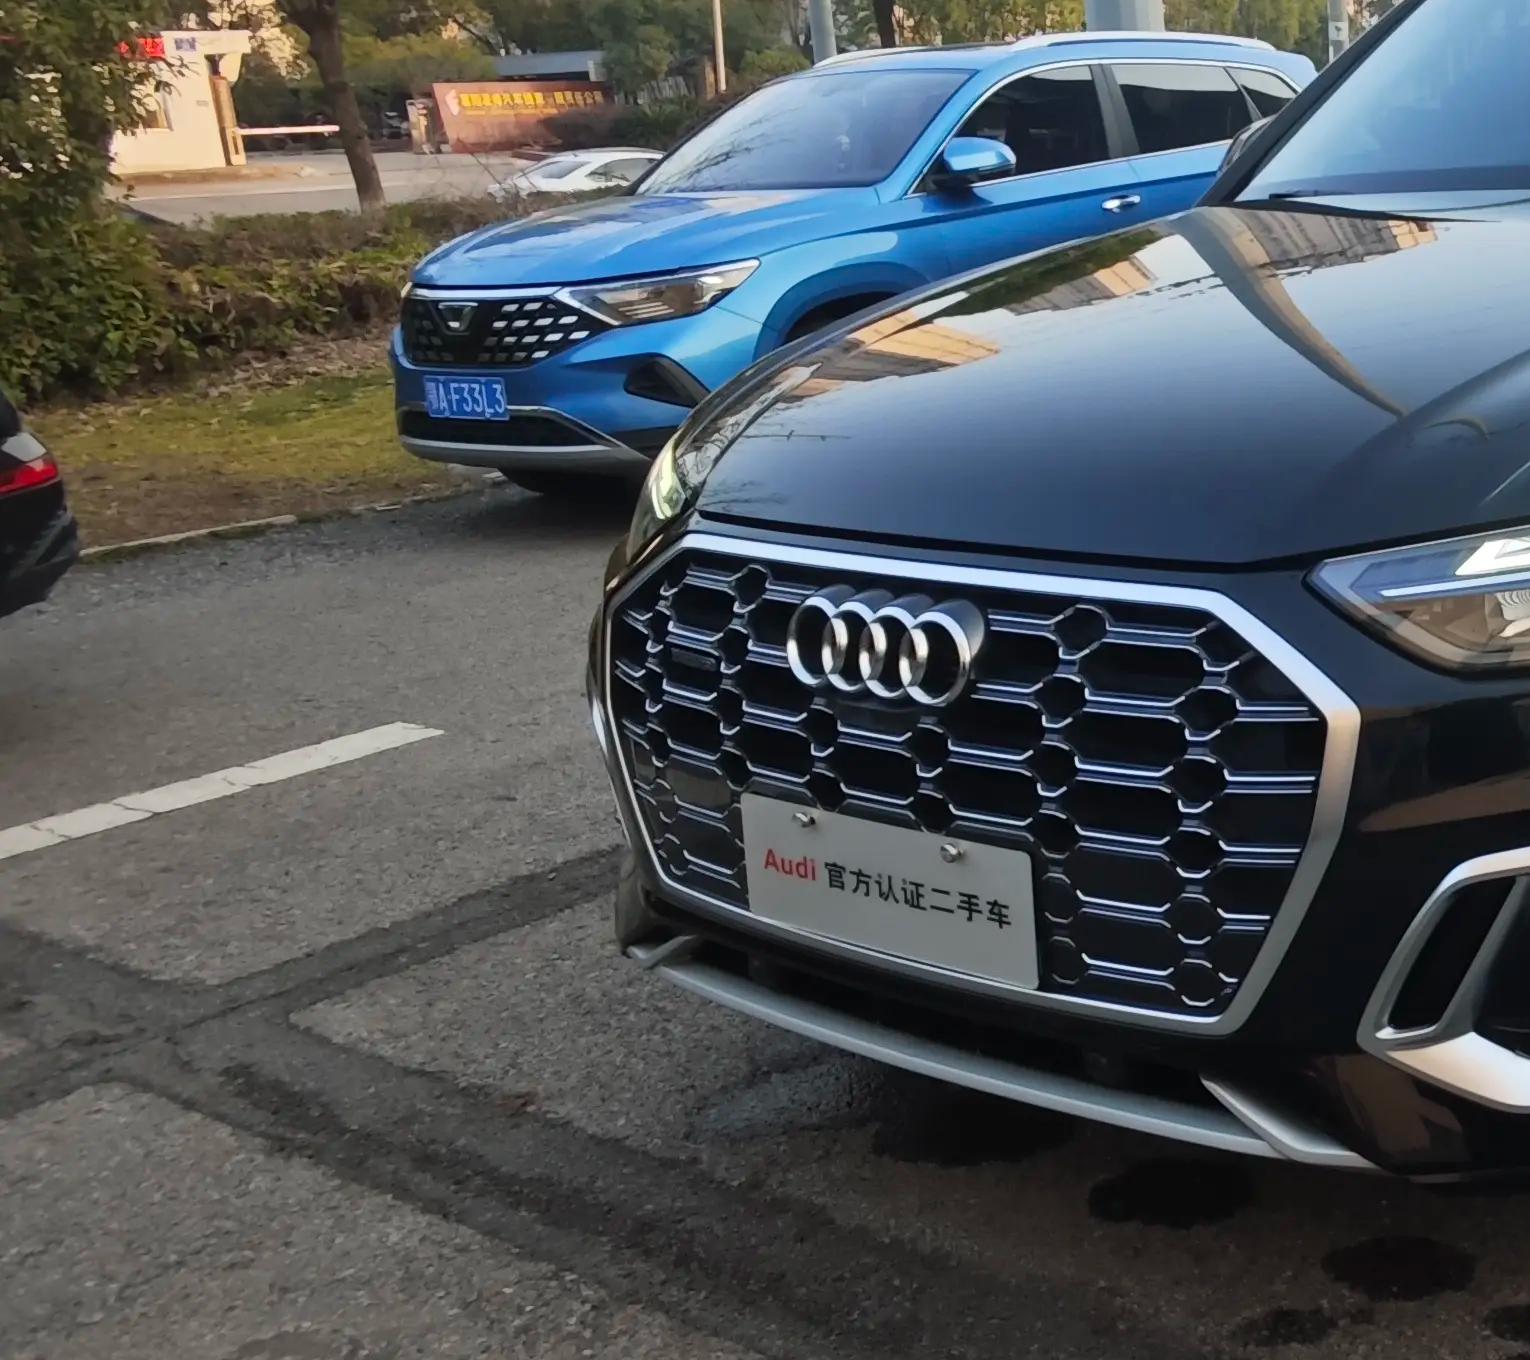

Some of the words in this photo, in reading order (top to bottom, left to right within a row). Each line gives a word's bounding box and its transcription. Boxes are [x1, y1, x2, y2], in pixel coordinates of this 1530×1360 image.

[763, 848, 817, 881] Audi
[824, 861, 1012, 929] 官方认证二手车
